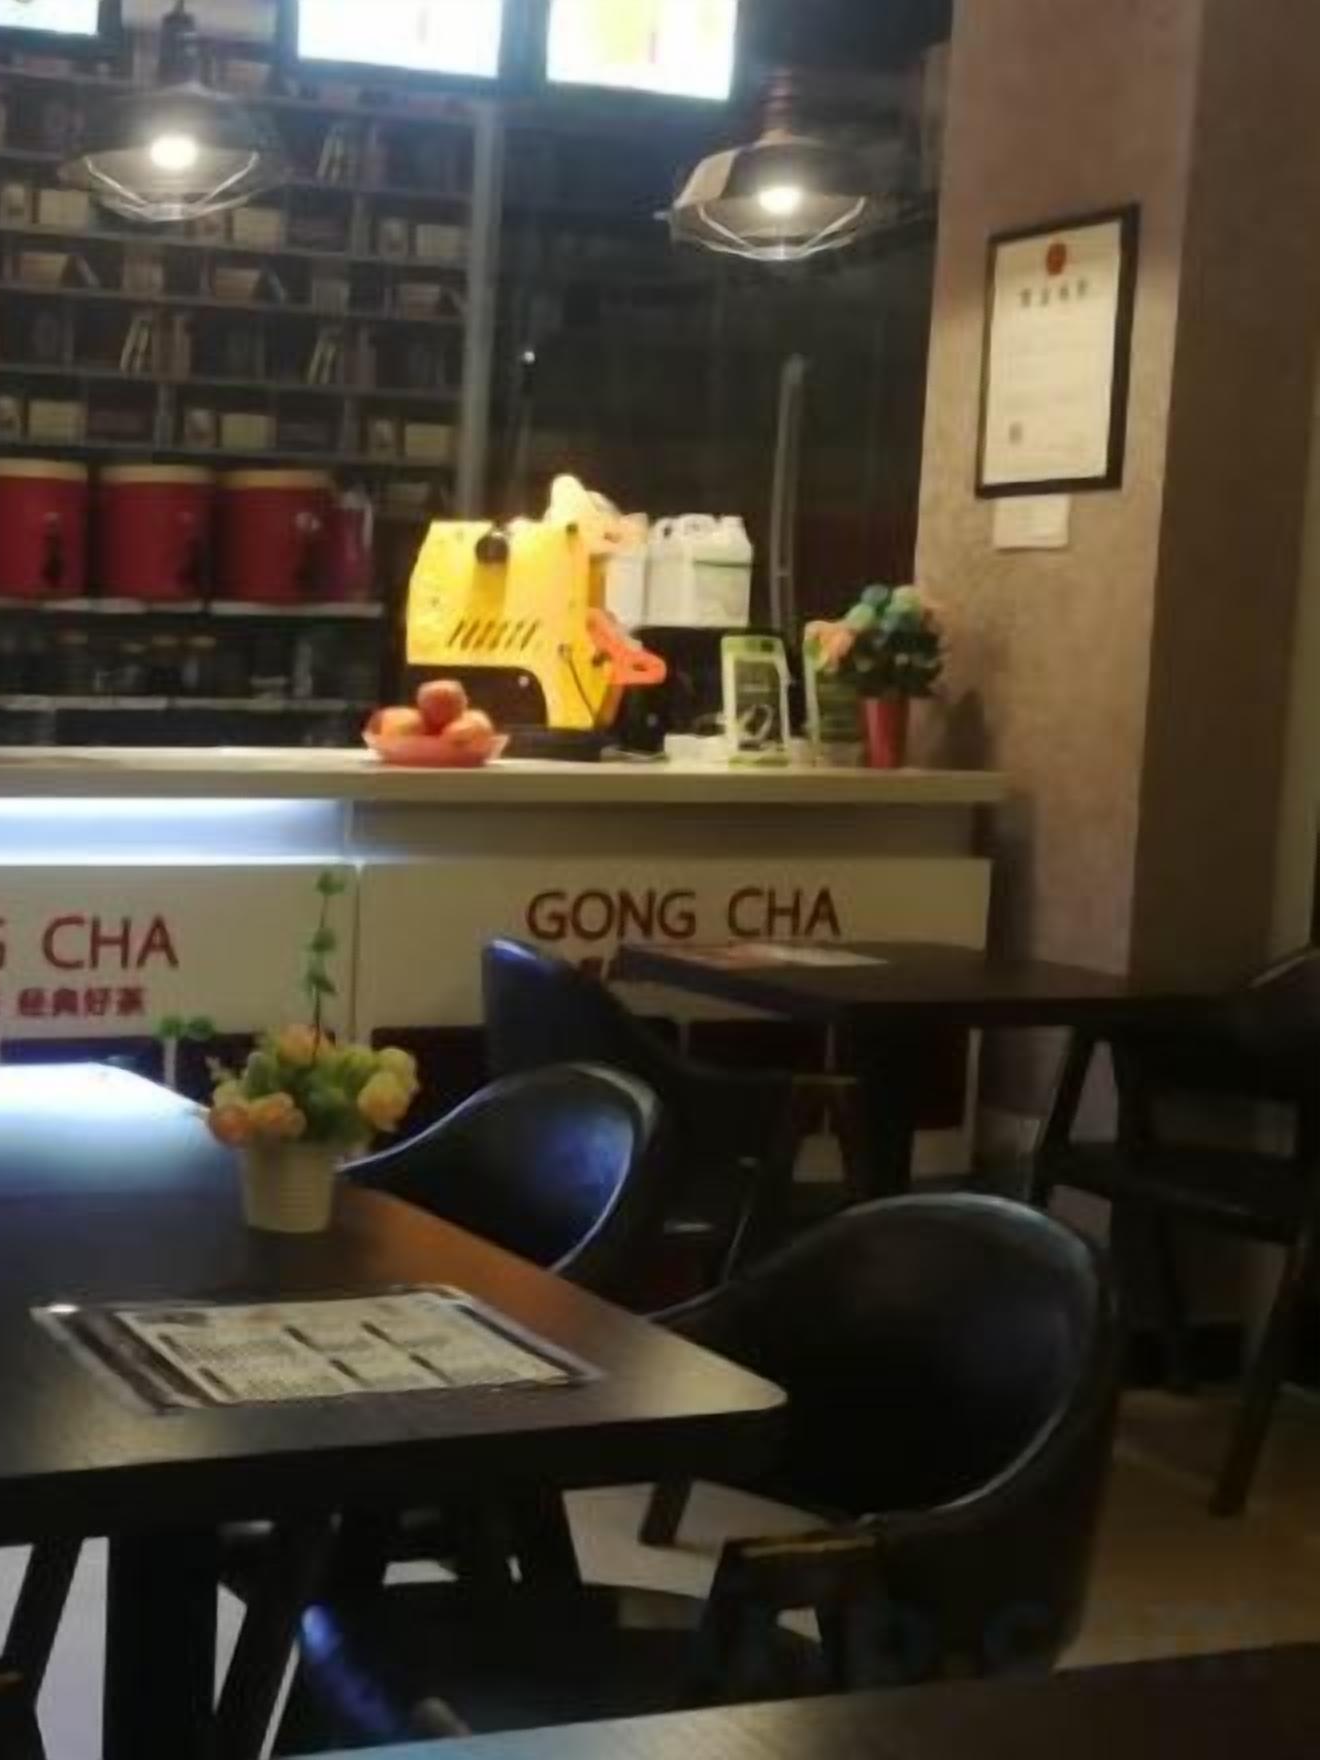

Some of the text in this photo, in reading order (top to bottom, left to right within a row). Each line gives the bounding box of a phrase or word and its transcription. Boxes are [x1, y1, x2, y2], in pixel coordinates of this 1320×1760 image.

[526, 887, 840, 940] GONG CHA
[43, 915, 179, 970] CHA
